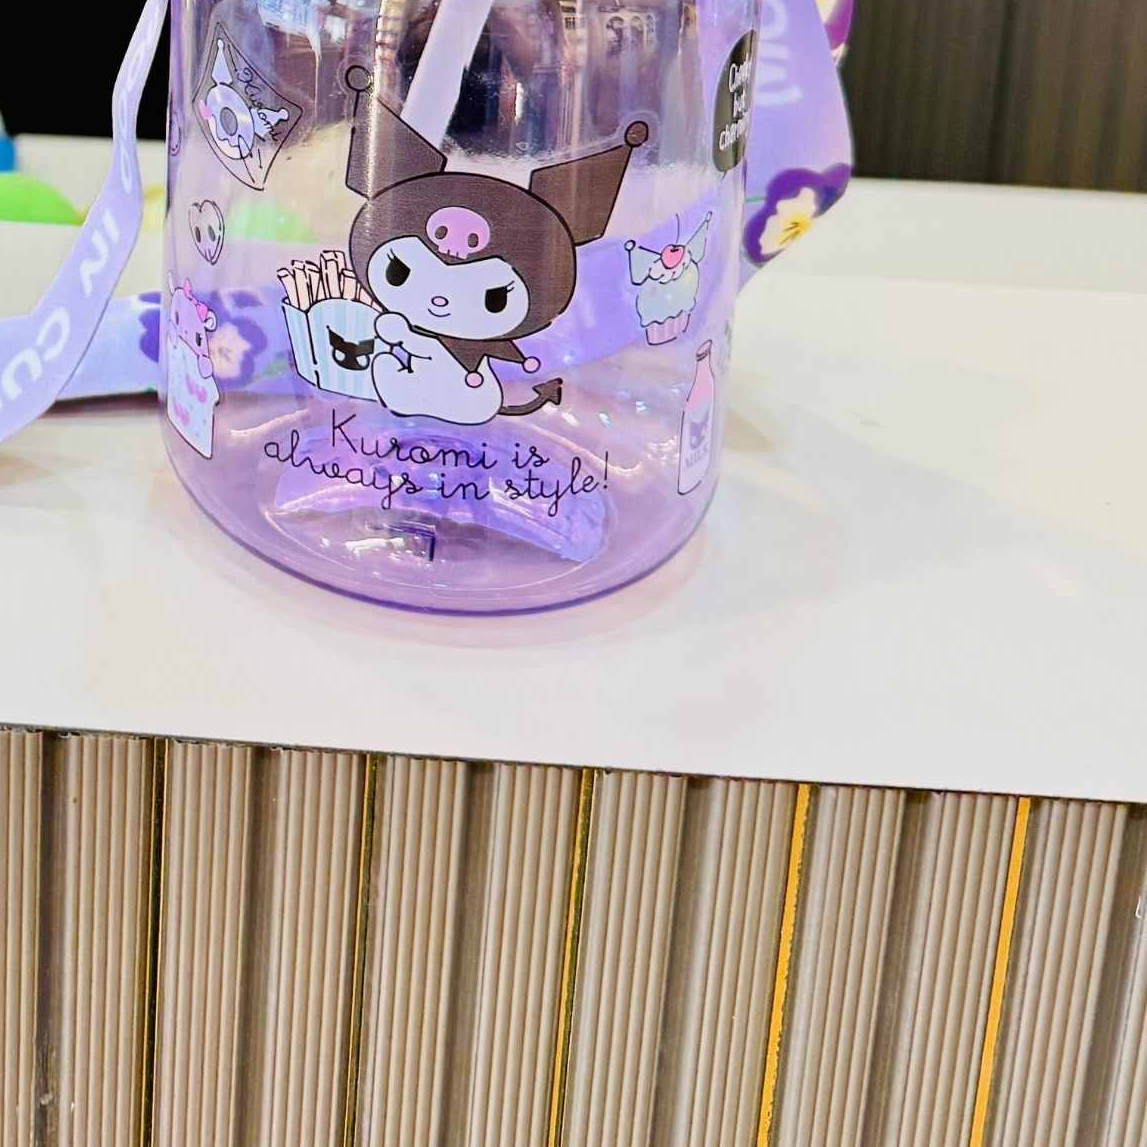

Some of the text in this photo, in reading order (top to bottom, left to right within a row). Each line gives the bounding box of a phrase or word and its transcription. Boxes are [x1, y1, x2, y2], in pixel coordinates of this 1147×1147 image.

[236, 67, 282, 142] Kuromi
[79, 208, 121, 298] IN
[264, 429, 609, 517] always in style!
[332, 408, 550, 470] Kuromi is
